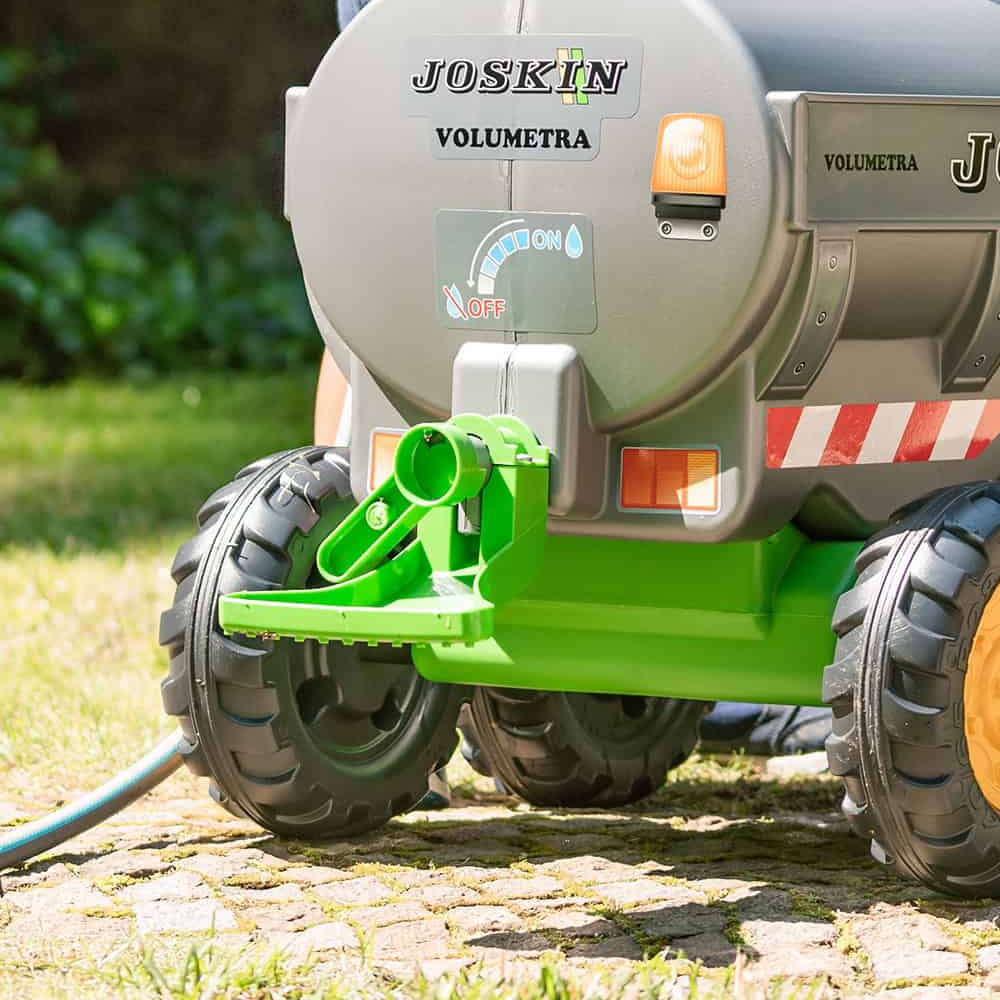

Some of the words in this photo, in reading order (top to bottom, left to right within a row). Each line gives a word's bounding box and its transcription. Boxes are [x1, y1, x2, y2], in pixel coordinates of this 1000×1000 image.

[412, 58, 628, 94] JOSKIN
[435, 127, 592, 149] VOLUMETRA
[824, 153, 919, 172] VOLUMETRA
[531, 229, 562, 250] ON
[467, 298, 506, 319] OFF
